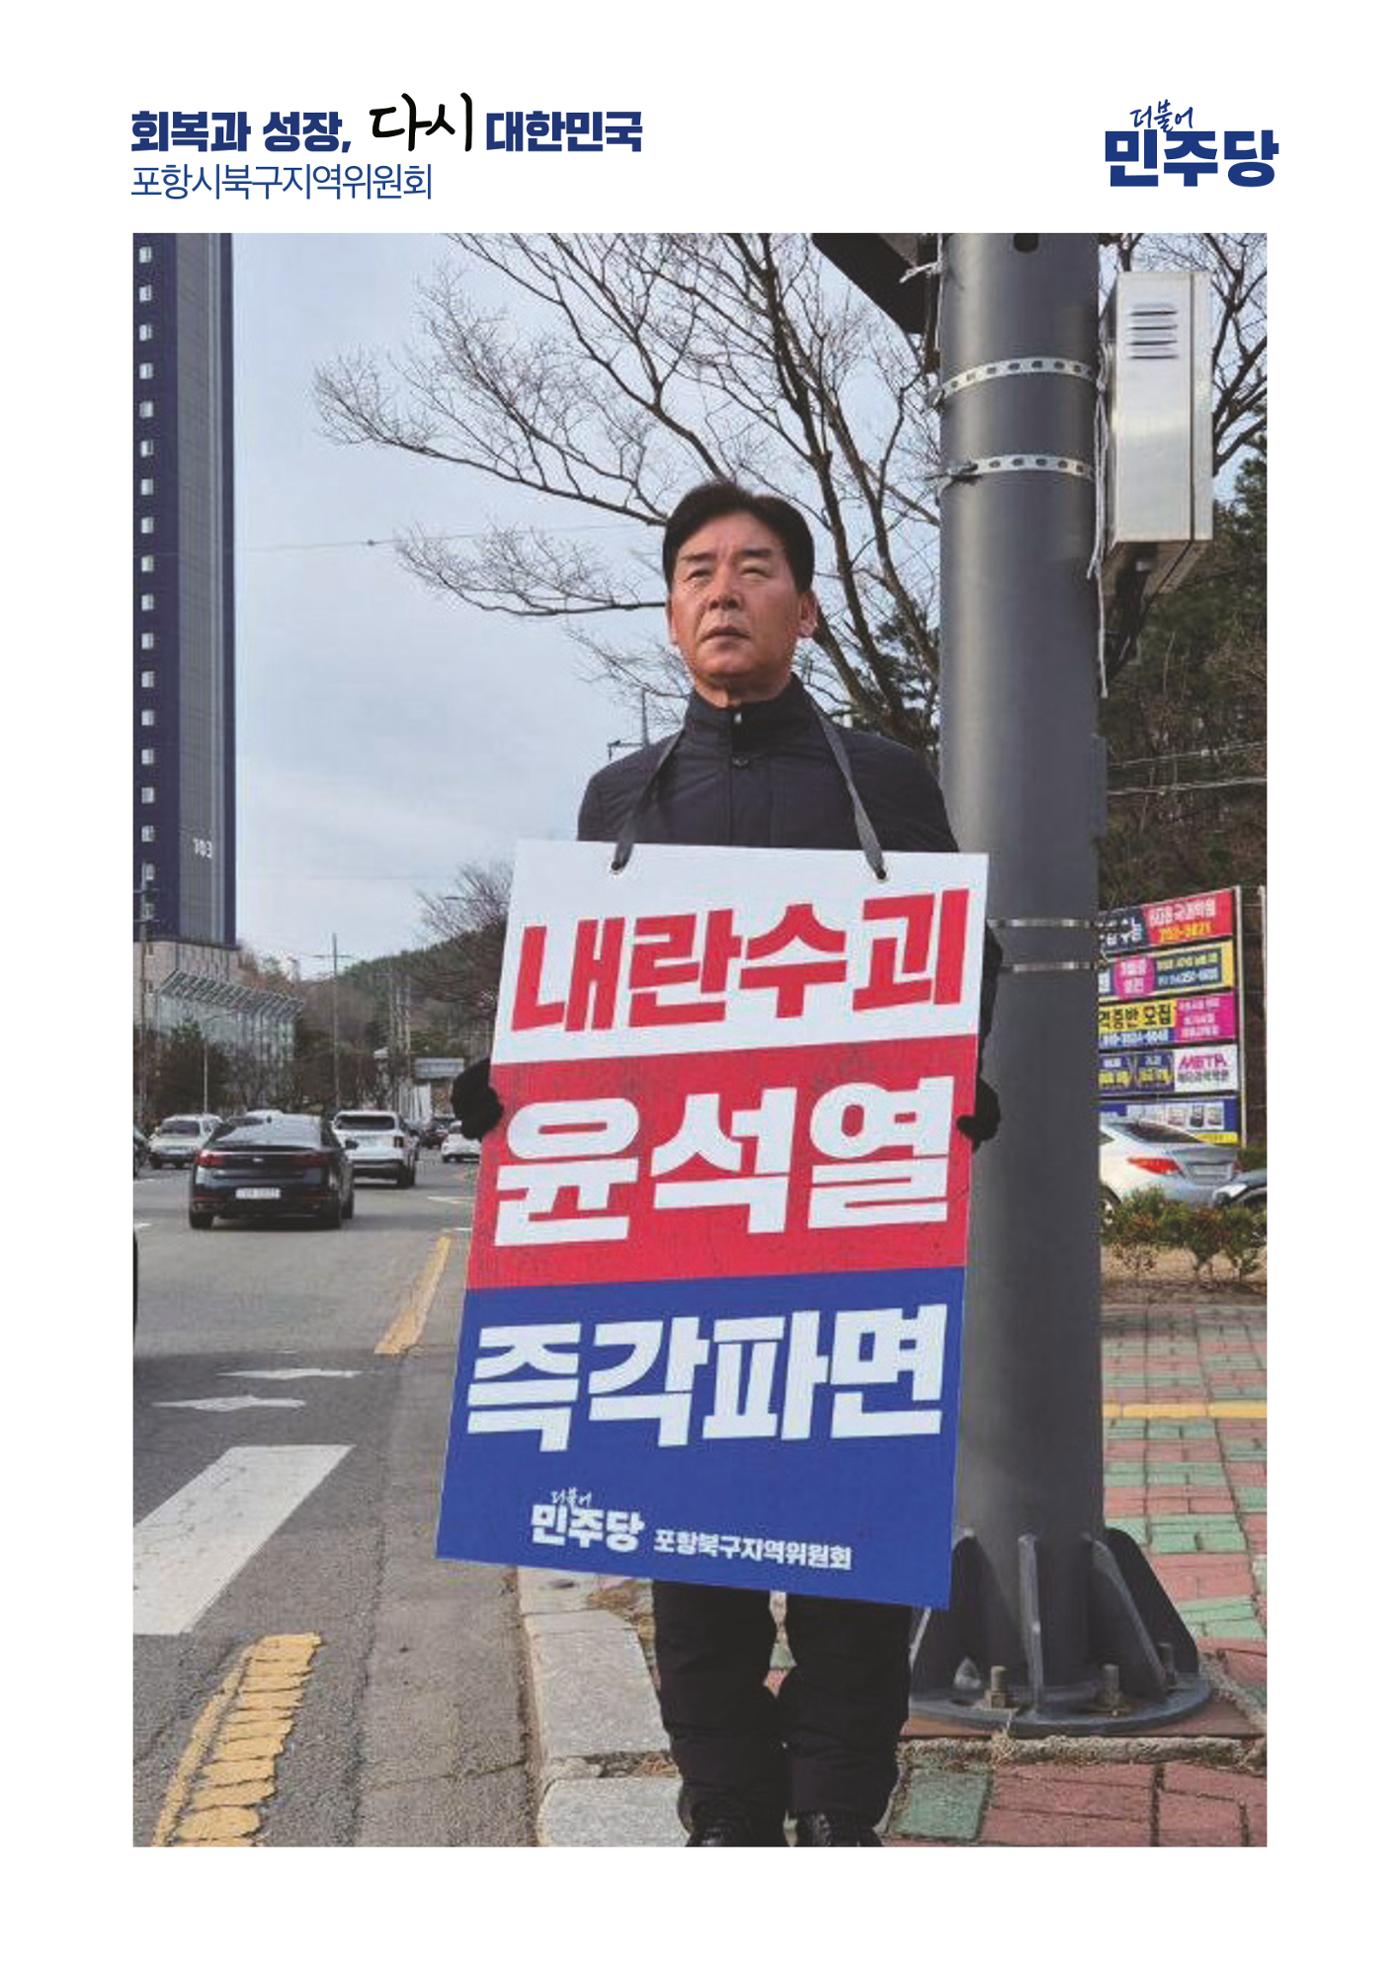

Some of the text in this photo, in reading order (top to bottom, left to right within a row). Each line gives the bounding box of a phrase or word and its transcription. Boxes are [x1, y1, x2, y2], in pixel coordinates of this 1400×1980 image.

[512, 889, 969, 1032] 내란수괴
[1178, 1052, 1228, 1069] META
[494, 1075, 955, 1247] 윤석열
[468, 1303, 948, 1452] 즉각파면
[531, 1504, 852, 1570] 민주당 포항북구지역위원회
